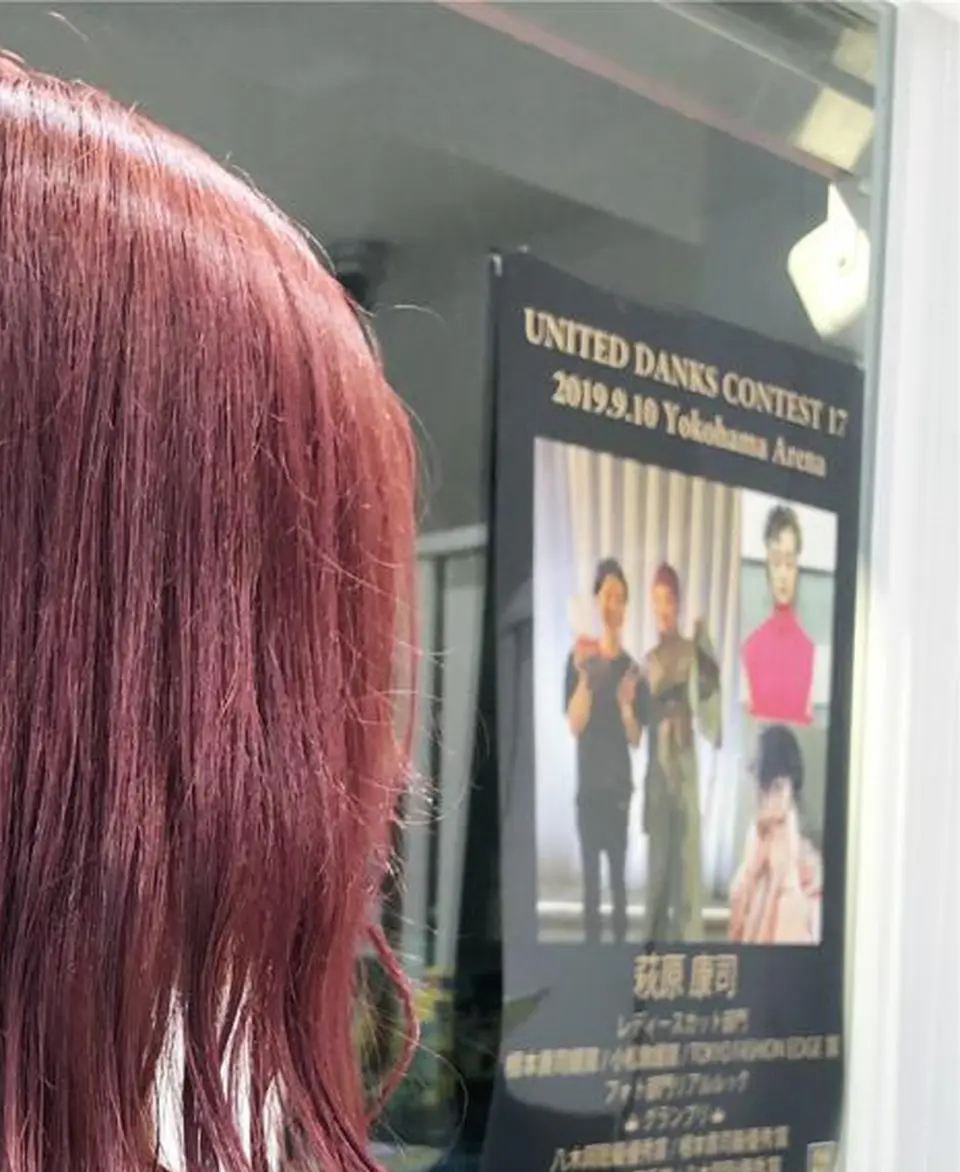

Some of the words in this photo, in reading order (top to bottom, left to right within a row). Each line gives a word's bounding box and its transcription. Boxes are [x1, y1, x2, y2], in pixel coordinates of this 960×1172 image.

[524, 307, 629, 370] UNITED
[634, 342, 718, 398] DANKS
[722, 371, 823, 431] CONTEST
[552, 370, 659, 430] 2019.9.10
[663, 400, 767, 462] Yokohama
[772, 436, 827, 478] Arena
